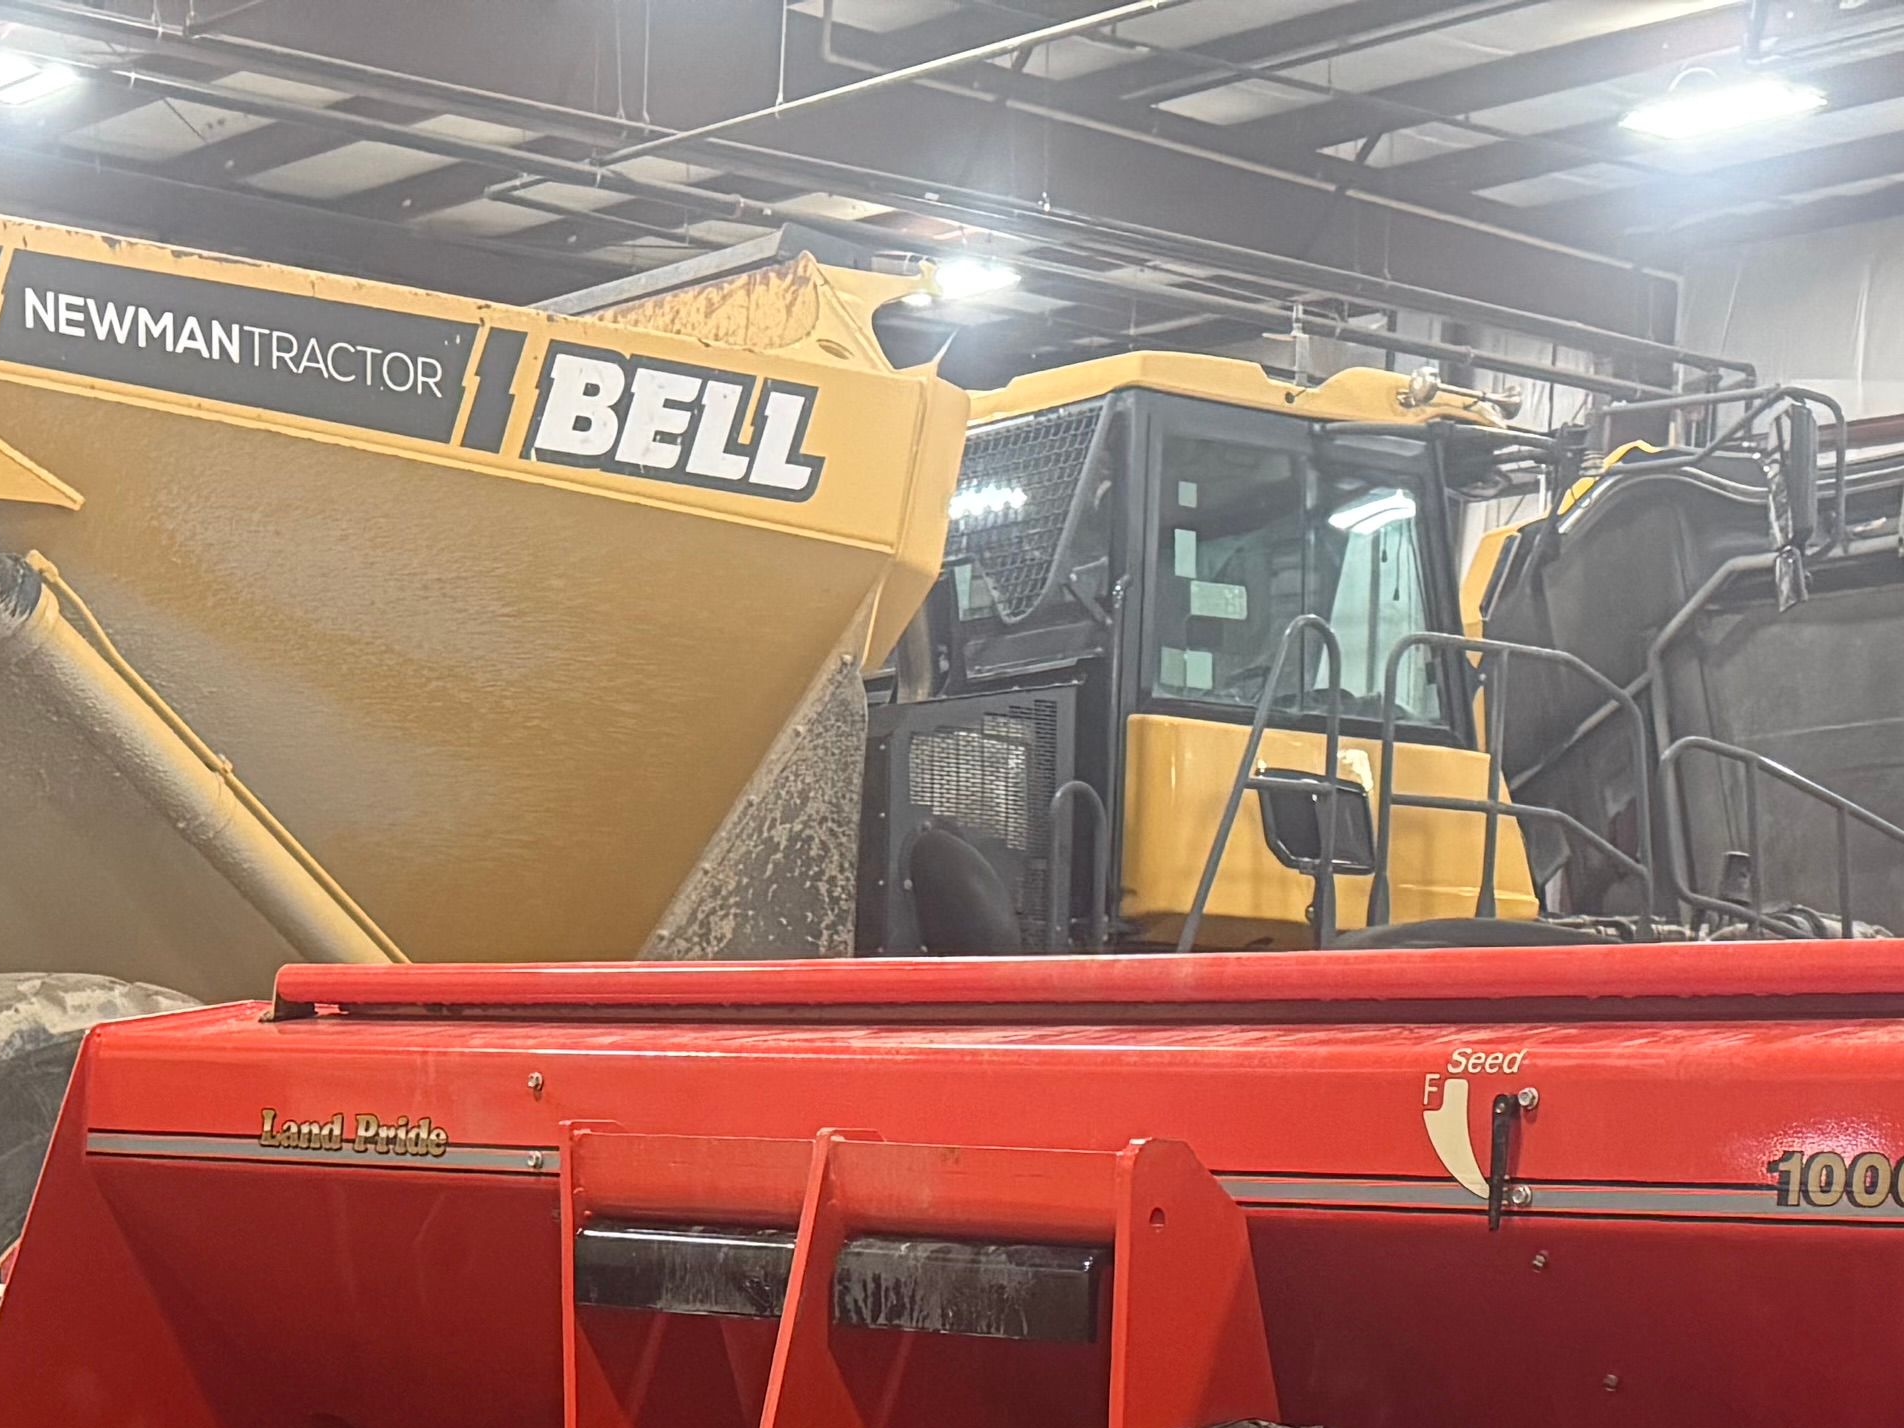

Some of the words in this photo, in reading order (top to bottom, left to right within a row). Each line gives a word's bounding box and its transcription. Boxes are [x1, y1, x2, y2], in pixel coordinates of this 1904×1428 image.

[22, 286, 444, 399] NEWMANTRACTOR
[533, 351, 822, 495] BELL
[1447, 1047, 1527, 1075] Seed
[1423, 1074, 1440, 1106] F
[259, 1108, 343, 1151] Land
[353, 1112, 448, 1157] Pride
